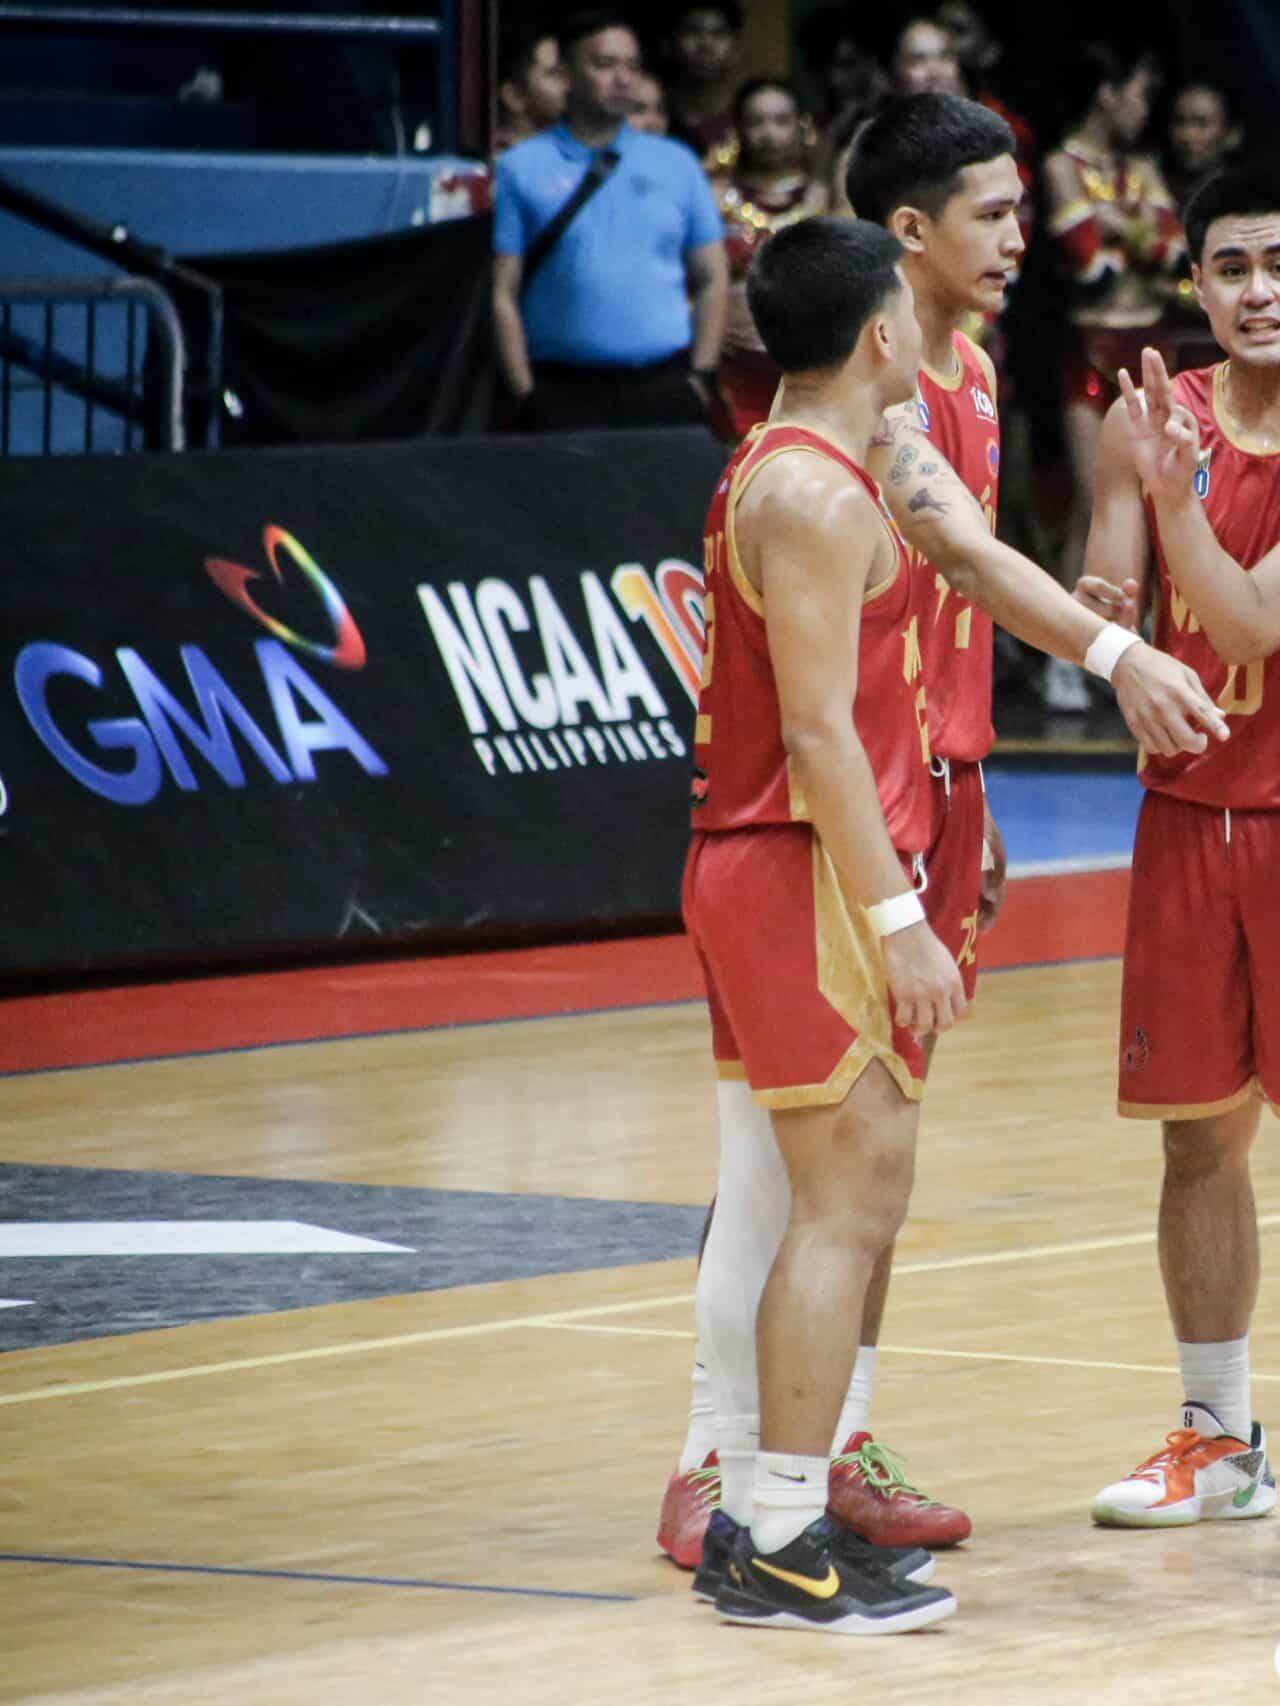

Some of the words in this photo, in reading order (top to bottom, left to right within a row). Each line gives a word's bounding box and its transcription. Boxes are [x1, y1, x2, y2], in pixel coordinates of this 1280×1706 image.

[14, 639, 389, 806] GMA
[416, 570, 668, 734] NCAA
[472, 714, 686, 776] PHILIPPINES
